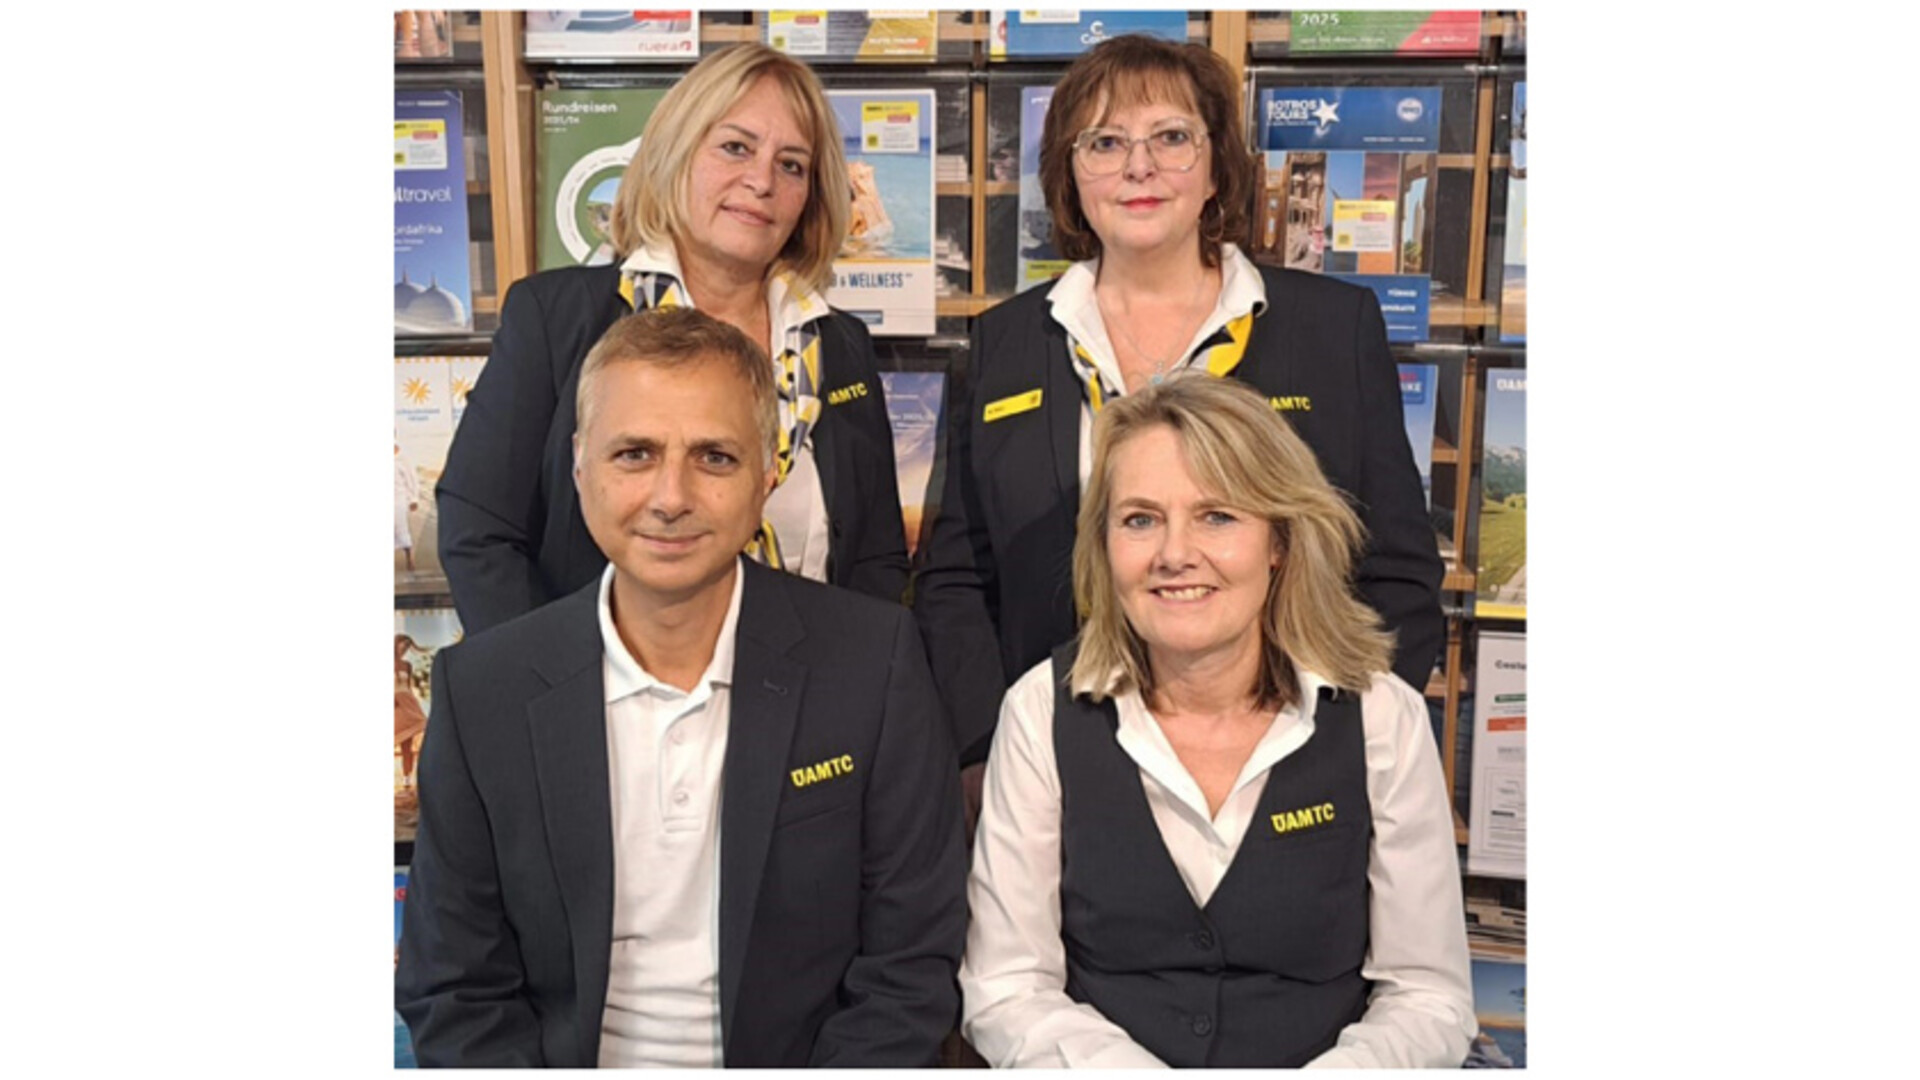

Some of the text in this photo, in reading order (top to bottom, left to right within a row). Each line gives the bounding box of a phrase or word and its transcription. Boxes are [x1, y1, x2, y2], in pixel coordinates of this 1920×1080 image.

[542, 100, 618, 114] Rundreisen
[849, 273, 904, 288] WELLNESS
[828, 382, 868, 405] AMTC
[1269, 396, 1311, 411] AMTC
